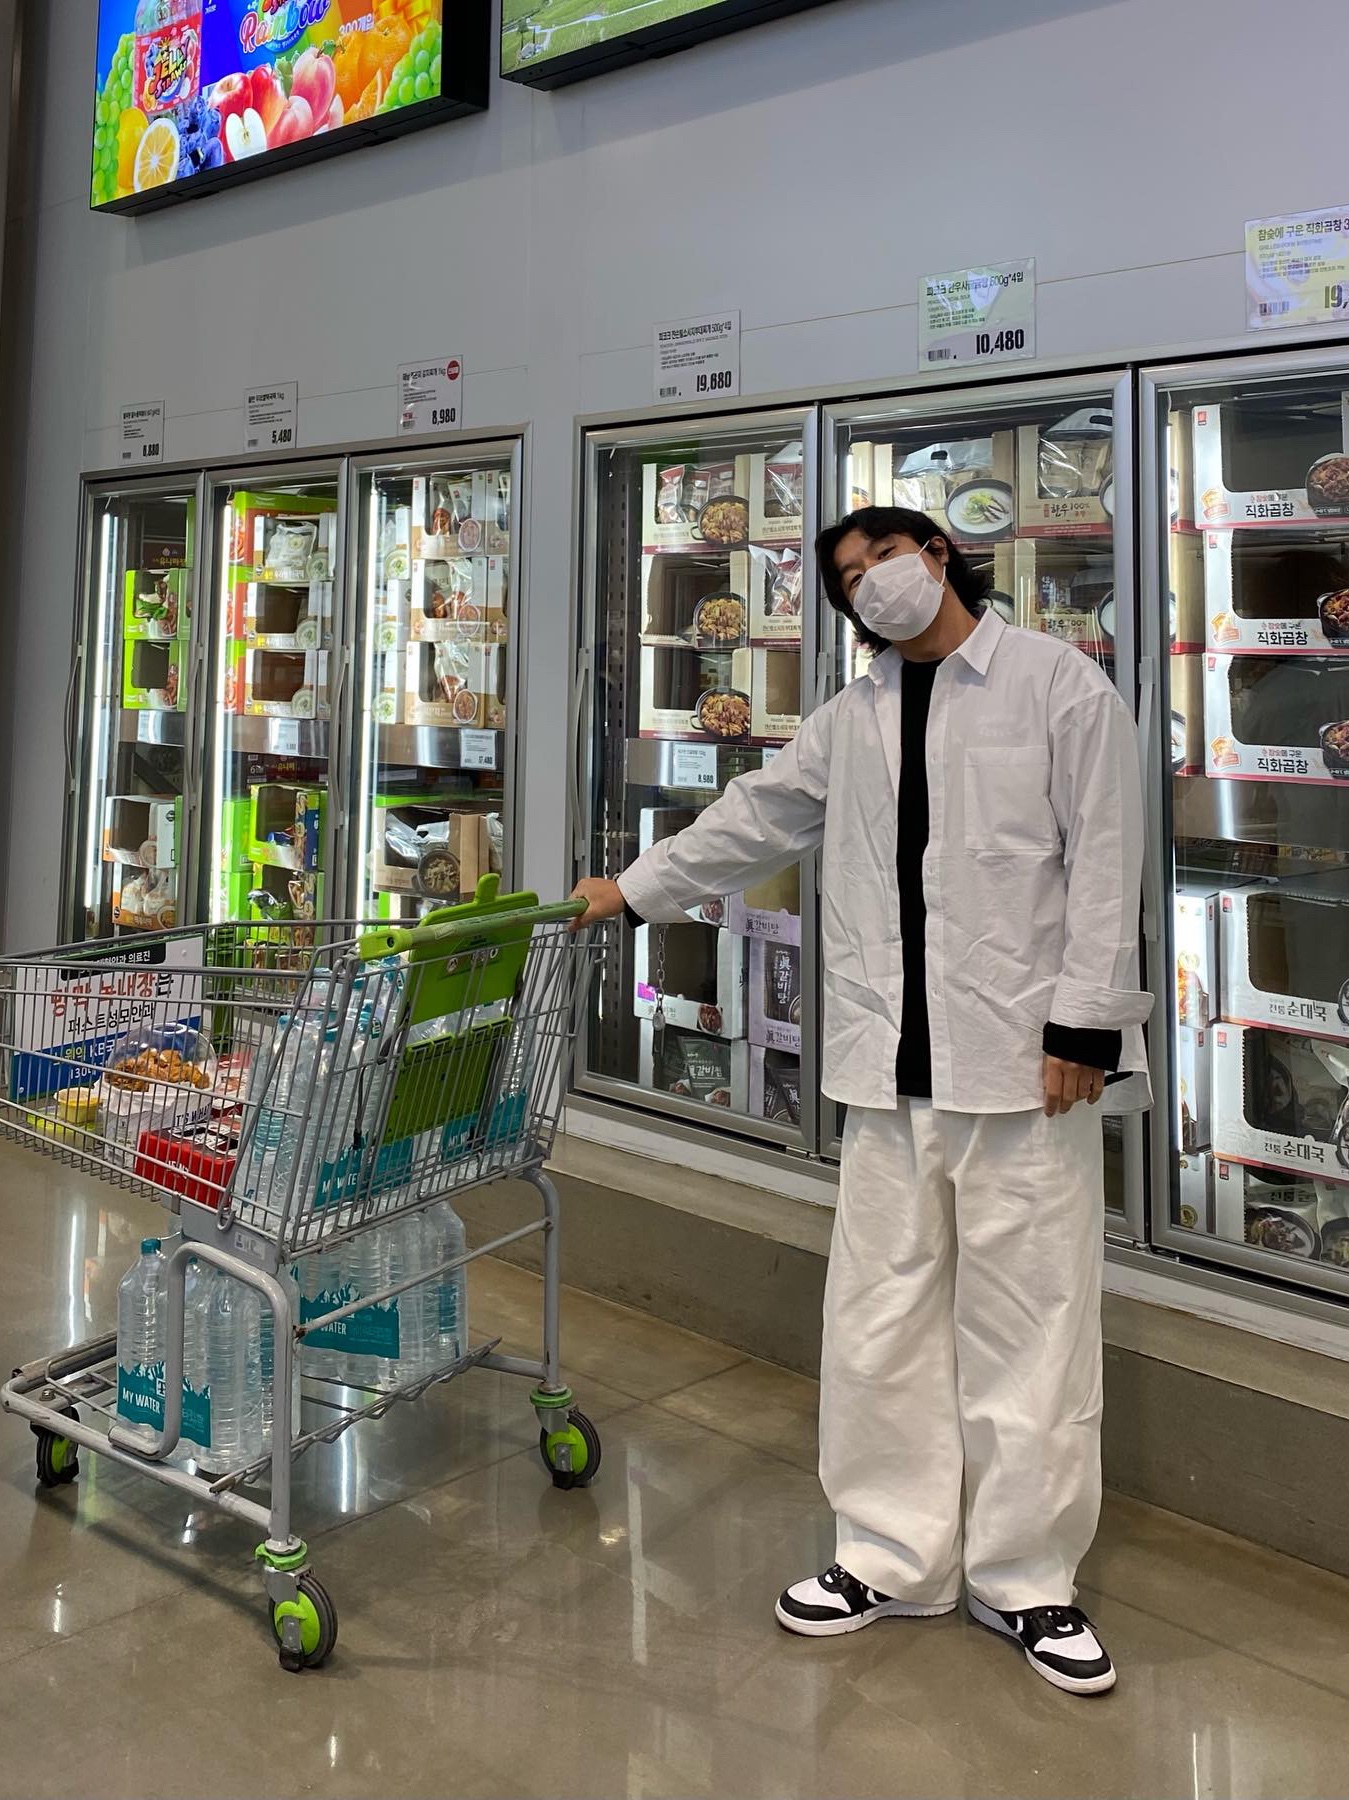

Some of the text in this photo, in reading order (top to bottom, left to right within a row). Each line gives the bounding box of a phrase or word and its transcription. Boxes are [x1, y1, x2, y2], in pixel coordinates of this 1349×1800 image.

[1305, 219, 1342, 235] 직화곱창
[976, 328, 1025, 355] 10,480
[432, 408, 456, 426] 8,980
[272, 428, 292, 445] 5,480
[1245, 502, 1294, 518] 직화곱창
[1257, 631, 1308, 646] 직화곱창
[1257, 757, 1309, 774] 직화곱창
[128, 950, 151, 963] 의료진
[68, 1003, 155, 1035] 퍼스트성모안과
[1269, 1001, 1327, 1022] 전통 순대국
[1264, 1141, 1325, 1163] 전통 순대국
[122, 1387, 160, 1414] MY WATER
